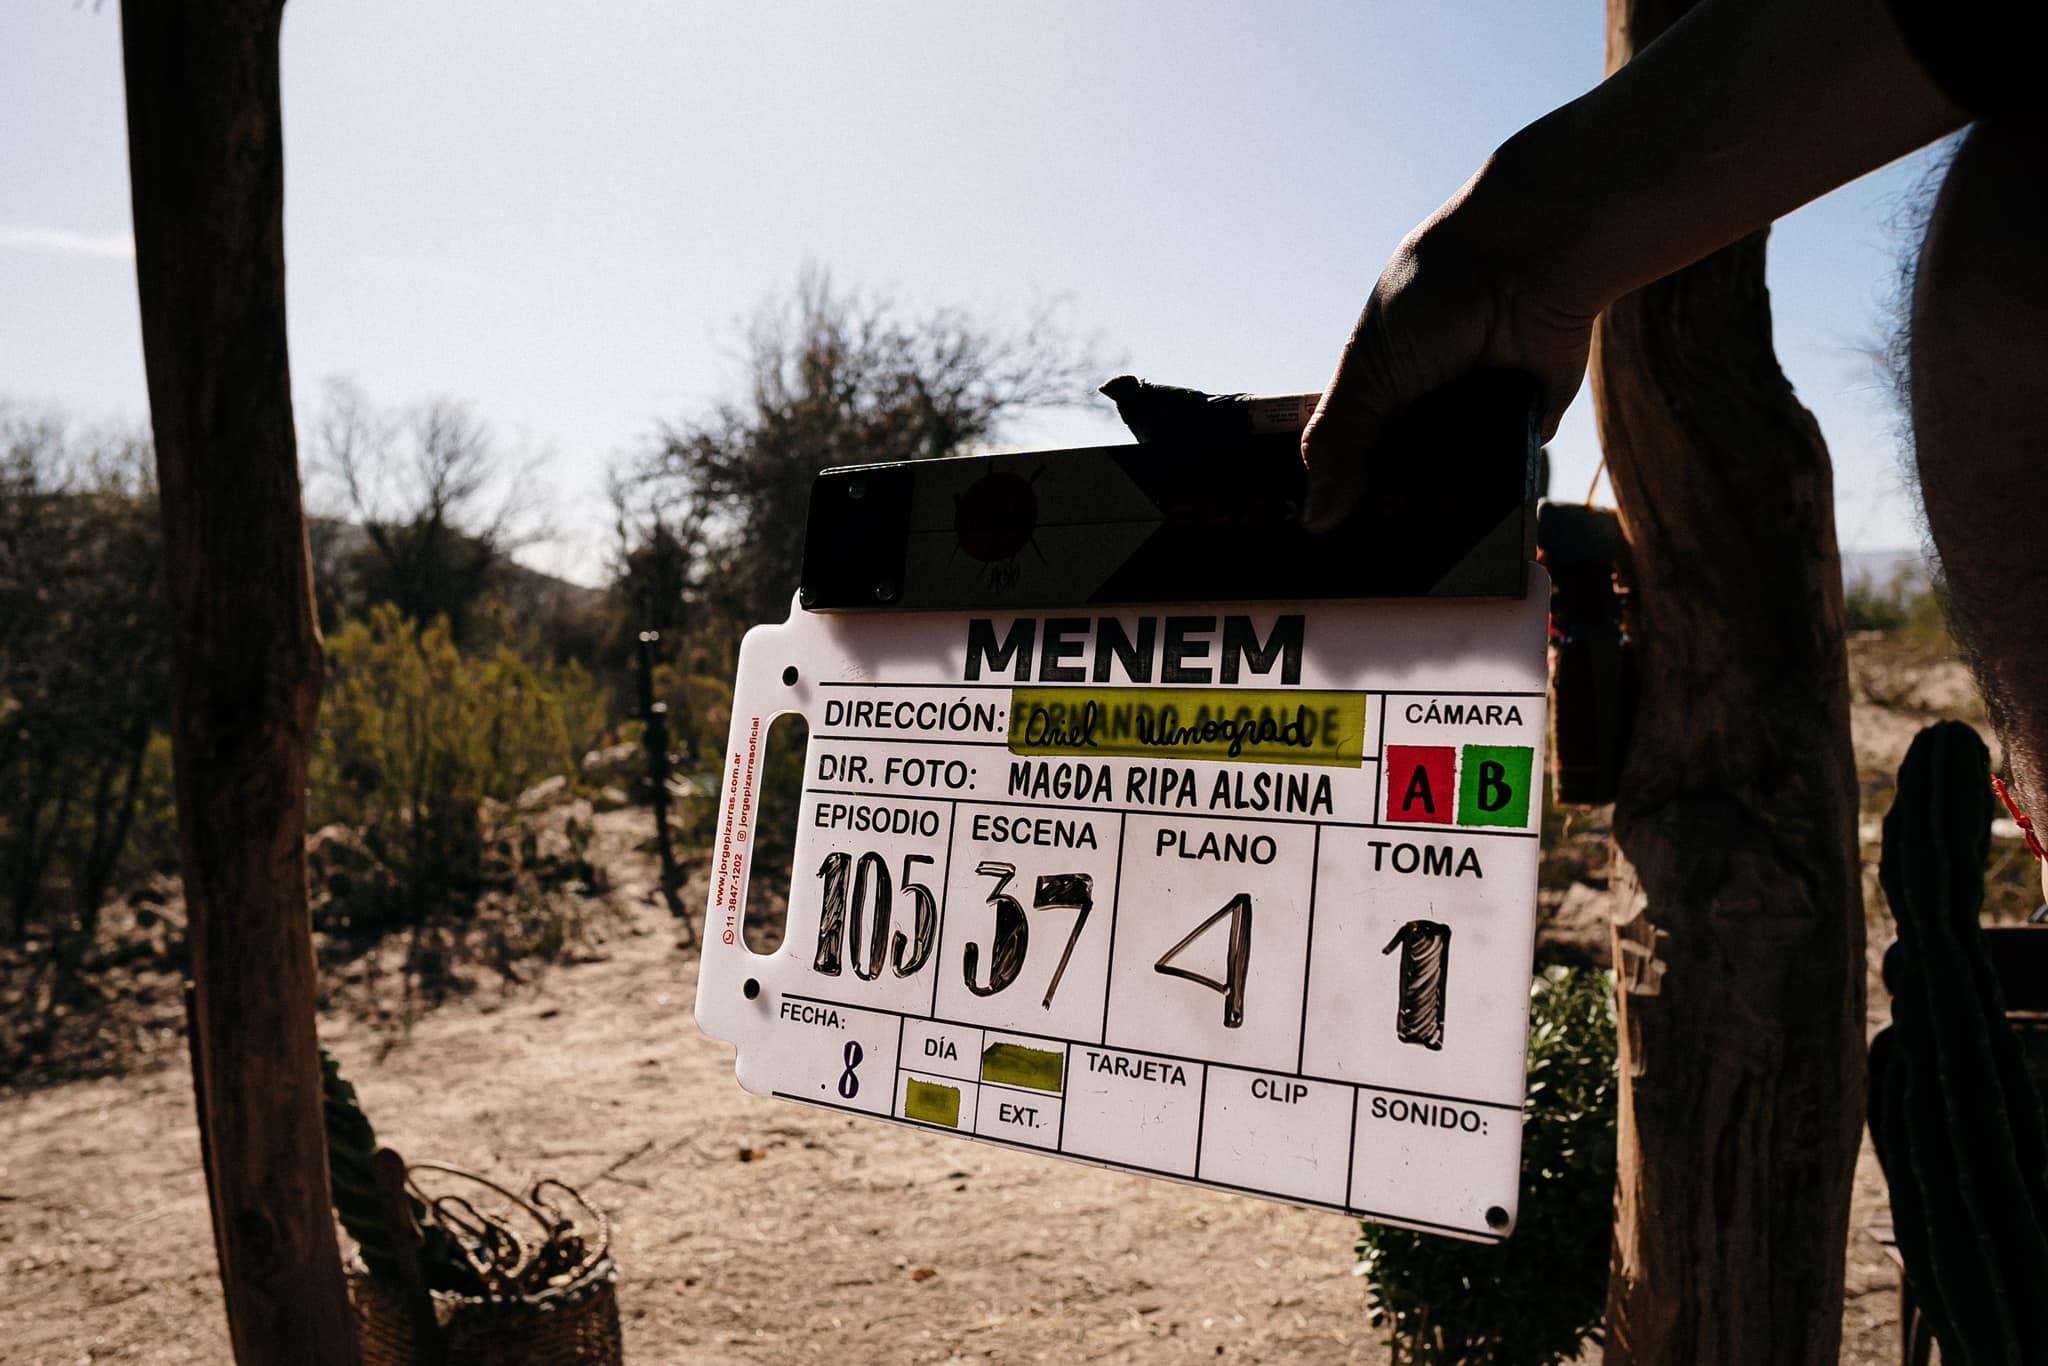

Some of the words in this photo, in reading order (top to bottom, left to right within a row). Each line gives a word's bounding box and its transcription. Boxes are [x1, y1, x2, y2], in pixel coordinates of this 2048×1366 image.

[963, 615, 1305, 685] MENEM
[824, 696, 1006, 733] DIRECCIÓN:
[1024, 699, 1099, 748] Ariel
[1405, 699, 1524, 726] CÁMARA
[738, 717, 760, 828] jorgepizarrasoficial
[818, 754, 875, 784] DIR.
[884, 757, 978, 790] FOTO:
[1008, 760, 1113, 803] MAGDA
[1125, 766, 1198, 809] RIPA
[1209, 769, 1334, 816] ALSINA
[1402, 764, 1436, 814] A
[1477, 760, 1513, 813] B
[715, 752, 742, 906] www.jorgepizarras.com.ar
[814, 803, 940, 838] EPISODIO
[971, 814, 1098, 850] ESCENA
[1156, 829, 1277, 865] PLANO
[1367, 841, 1483, 879] TOMA
[728, 853, 743, 912] 3847-1202
[726, 915, 735, 928] 11
[813, 851, 938, 981] 105
[963, 861, 1094, 1012] 37
[1154, 893, 1252, 1028] 4
[1382, 919, 1452, 1051] 1
[780, 1002, 846, 1029] FECHA:
[924, 1036, 958, 1061] DÍA
[1087, 1052, 1187, 1086] TARJETA
[1250, 1078, 1309, 1104] CLIP
[999, 1103, 1040, 1129] EXT.
[1371, 1096, 1489, 1135] SONIDO:
